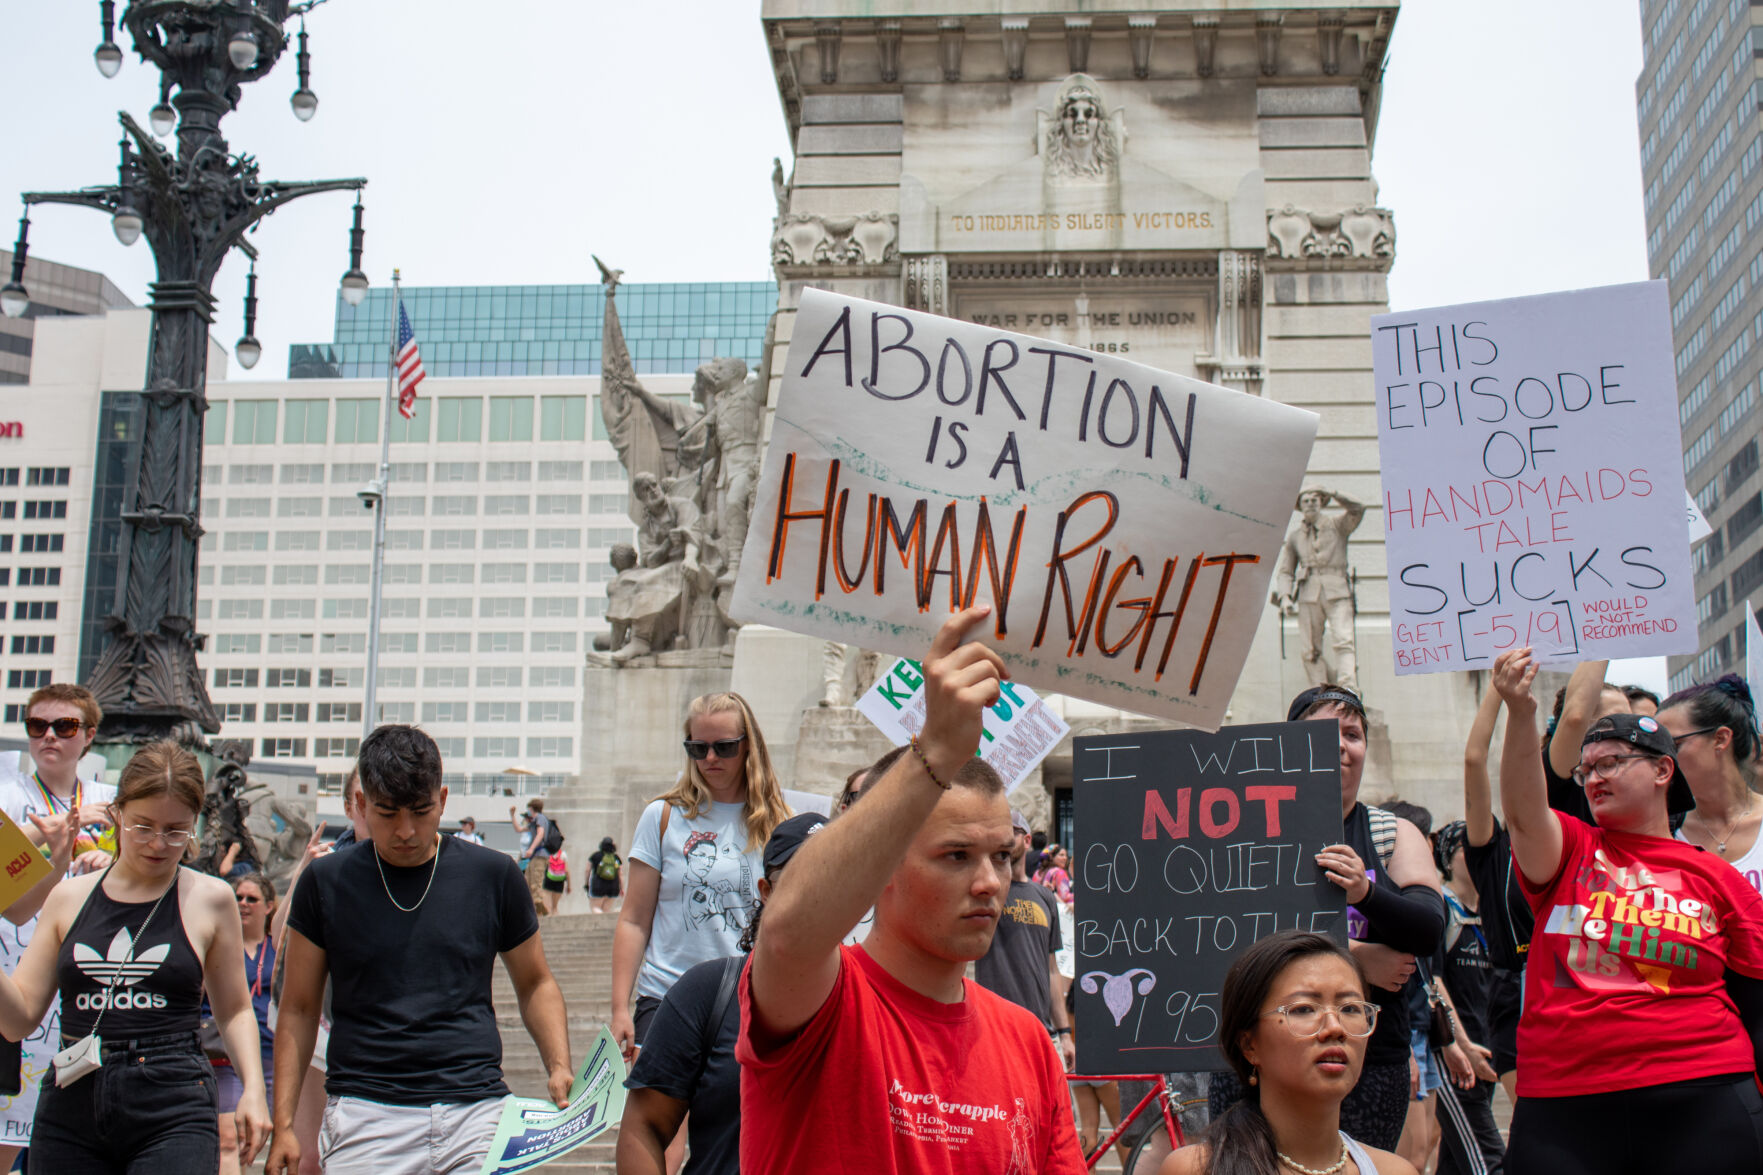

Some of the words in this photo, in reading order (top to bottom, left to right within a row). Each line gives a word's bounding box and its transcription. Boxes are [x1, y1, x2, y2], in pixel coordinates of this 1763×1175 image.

[952, 215, 975, 232] TO
[1066, 213, 1127, 231] SILENT
[1132, 211, 1215, 230] VICTORS.
[971, 313, 1018, 327] WAR
[1025, 313, 1070, 327] FOR
[1076, 312, 1120, 326] THE
[1128, 311, 1196, 326] UNION
[1378, 321, 1498, 376] THIS
[801, 306, 1198, 480] ABORTION
[1386, 365, 1637, 430] EPISODE
[926, 415, 970, 469] IS
[989, 431, 1025, 491] A
[1483, 425, 1559, 479] OF
[1387, 468, 1653, 531] HANDMAIDS
[1464, 511, 1575, 553] TALE
[766, 452, 1028, 640] HUMAN
[1031, 489, 1261, 697] RIGHT
[1400, 546, 1667, 615] SUCKS
[1582, 595, 1649, 614] WOULD
[1396, 621, 1446, 645] GET
[1396, 644, 1454, 668] BENT
[1083, 746, 1141, 782] I
[1190, 733, 1335, 774] WILL
[1141, 785, 1297, 840] NOT
[5, 851, 32, 878] ACLU
[1083, 843, 1139, 893] GO
[1164, 842, 1339, 894] QUIETL
[1002, 906, 1034, 917] NORTH
[1013, 914, 1035, 925] FACE
[1014, 898, 1033, 908] THE
[1589, 891, 1701, 940] Them
[1078, 917, 1177, 957] BACK
[1185, 915, 1237, 955] TO
[1566, 937, 1621, 977] Us
[1607, 922, 1699, 970] Him
[1456, 958, 1477, 967] TEAM
[75, 988, 168, 1010] adidas
[526, 1107, 592, 1144] ABORTION
[516, 1141, 550, 1157] TALK
